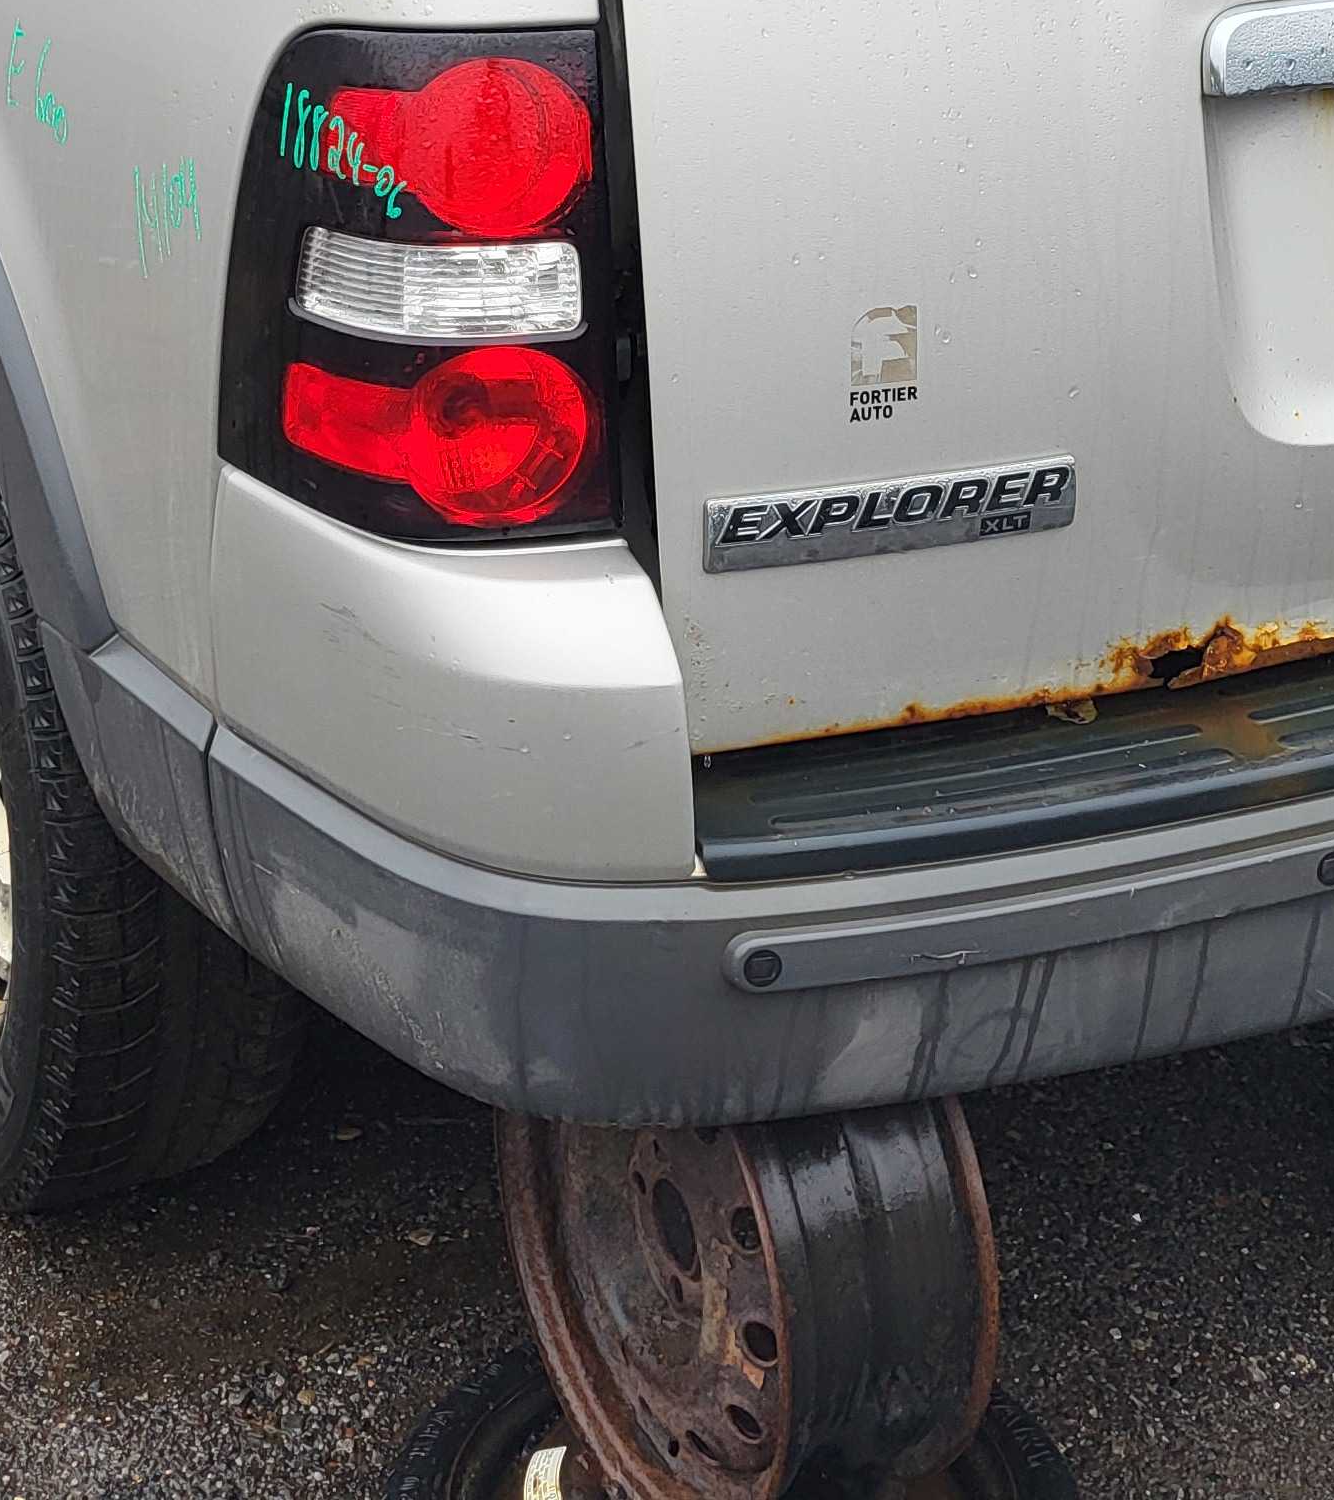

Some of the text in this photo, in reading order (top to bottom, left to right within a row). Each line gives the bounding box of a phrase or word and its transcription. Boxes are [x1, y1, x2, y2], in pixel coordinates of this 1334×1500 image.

[280, 83, 408, 218] 18824-06
[849, 386, 918, 406] FORTIER
[849, 405, 893, 423] AUTO
[714, 466, 1072, 548] EXPLORER
[981, 515, 1028, 533] XLT
